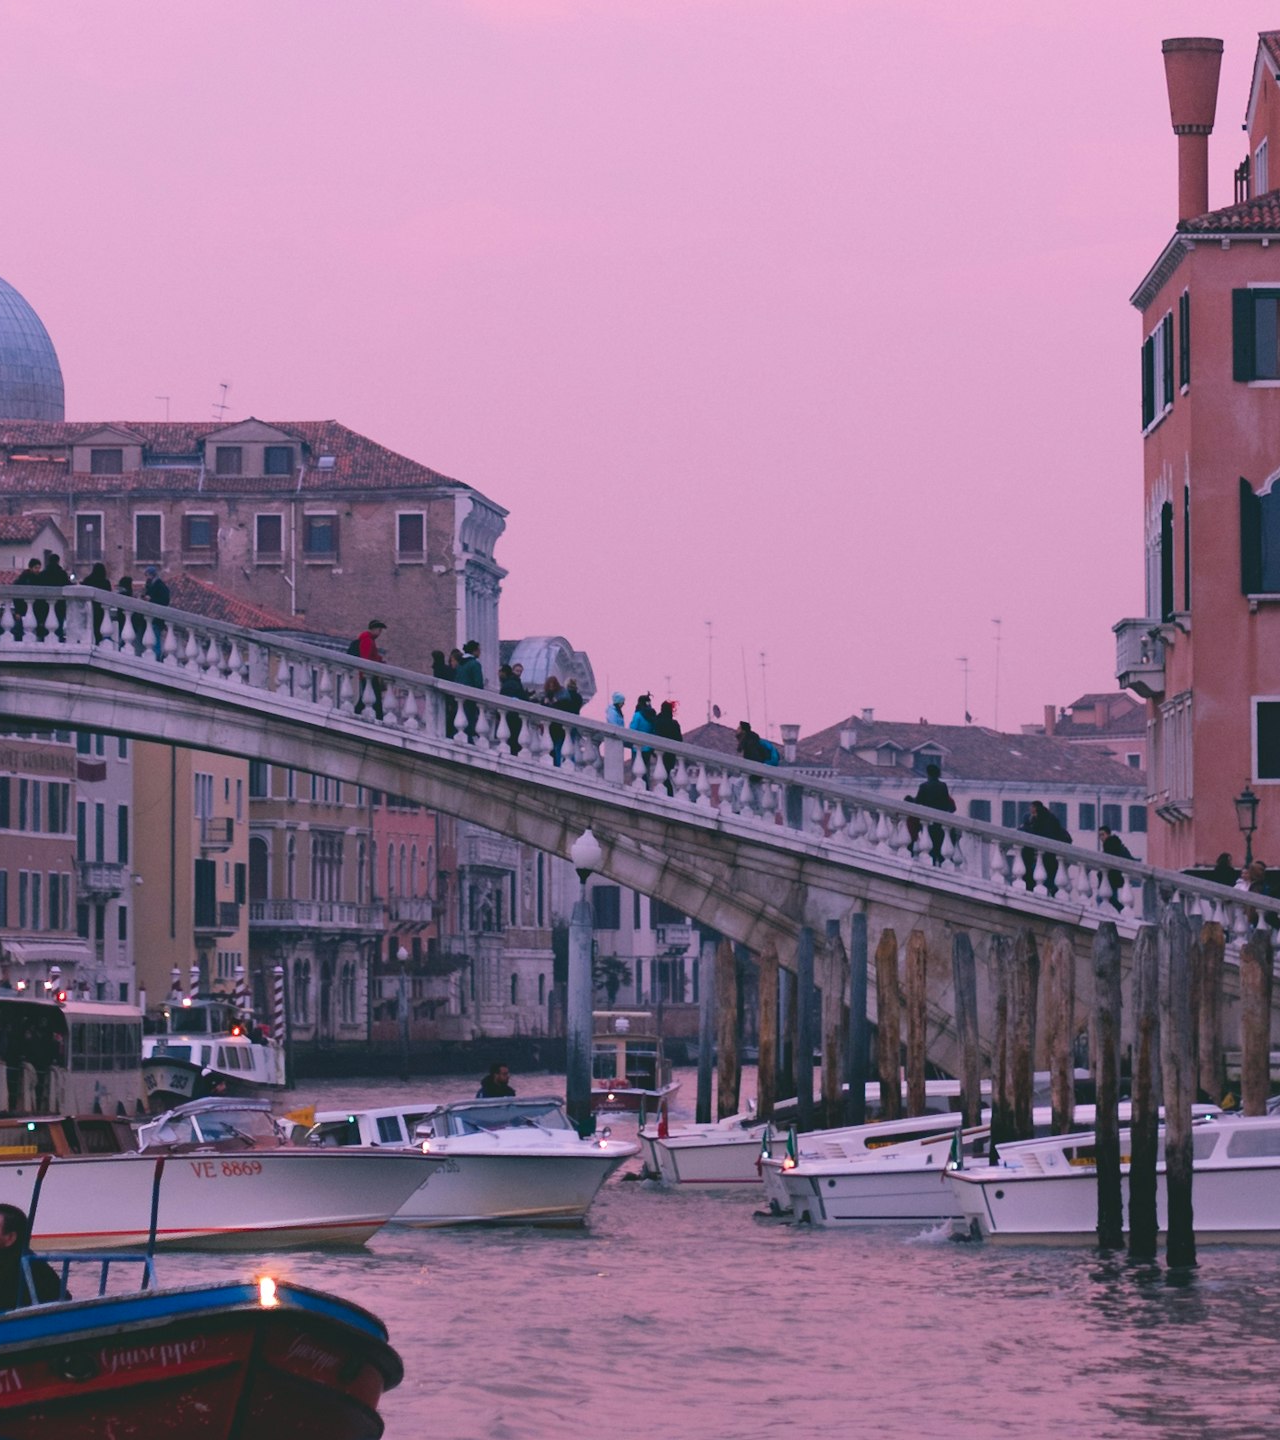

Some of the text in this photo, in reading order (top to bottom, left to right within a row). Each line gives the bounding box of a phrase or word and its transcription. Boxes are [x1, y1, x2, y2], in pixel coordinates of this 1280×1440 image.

[190, 1160, 263, 1179] VE 8869
[100, 1335, 207, 1375] Giuseppe
